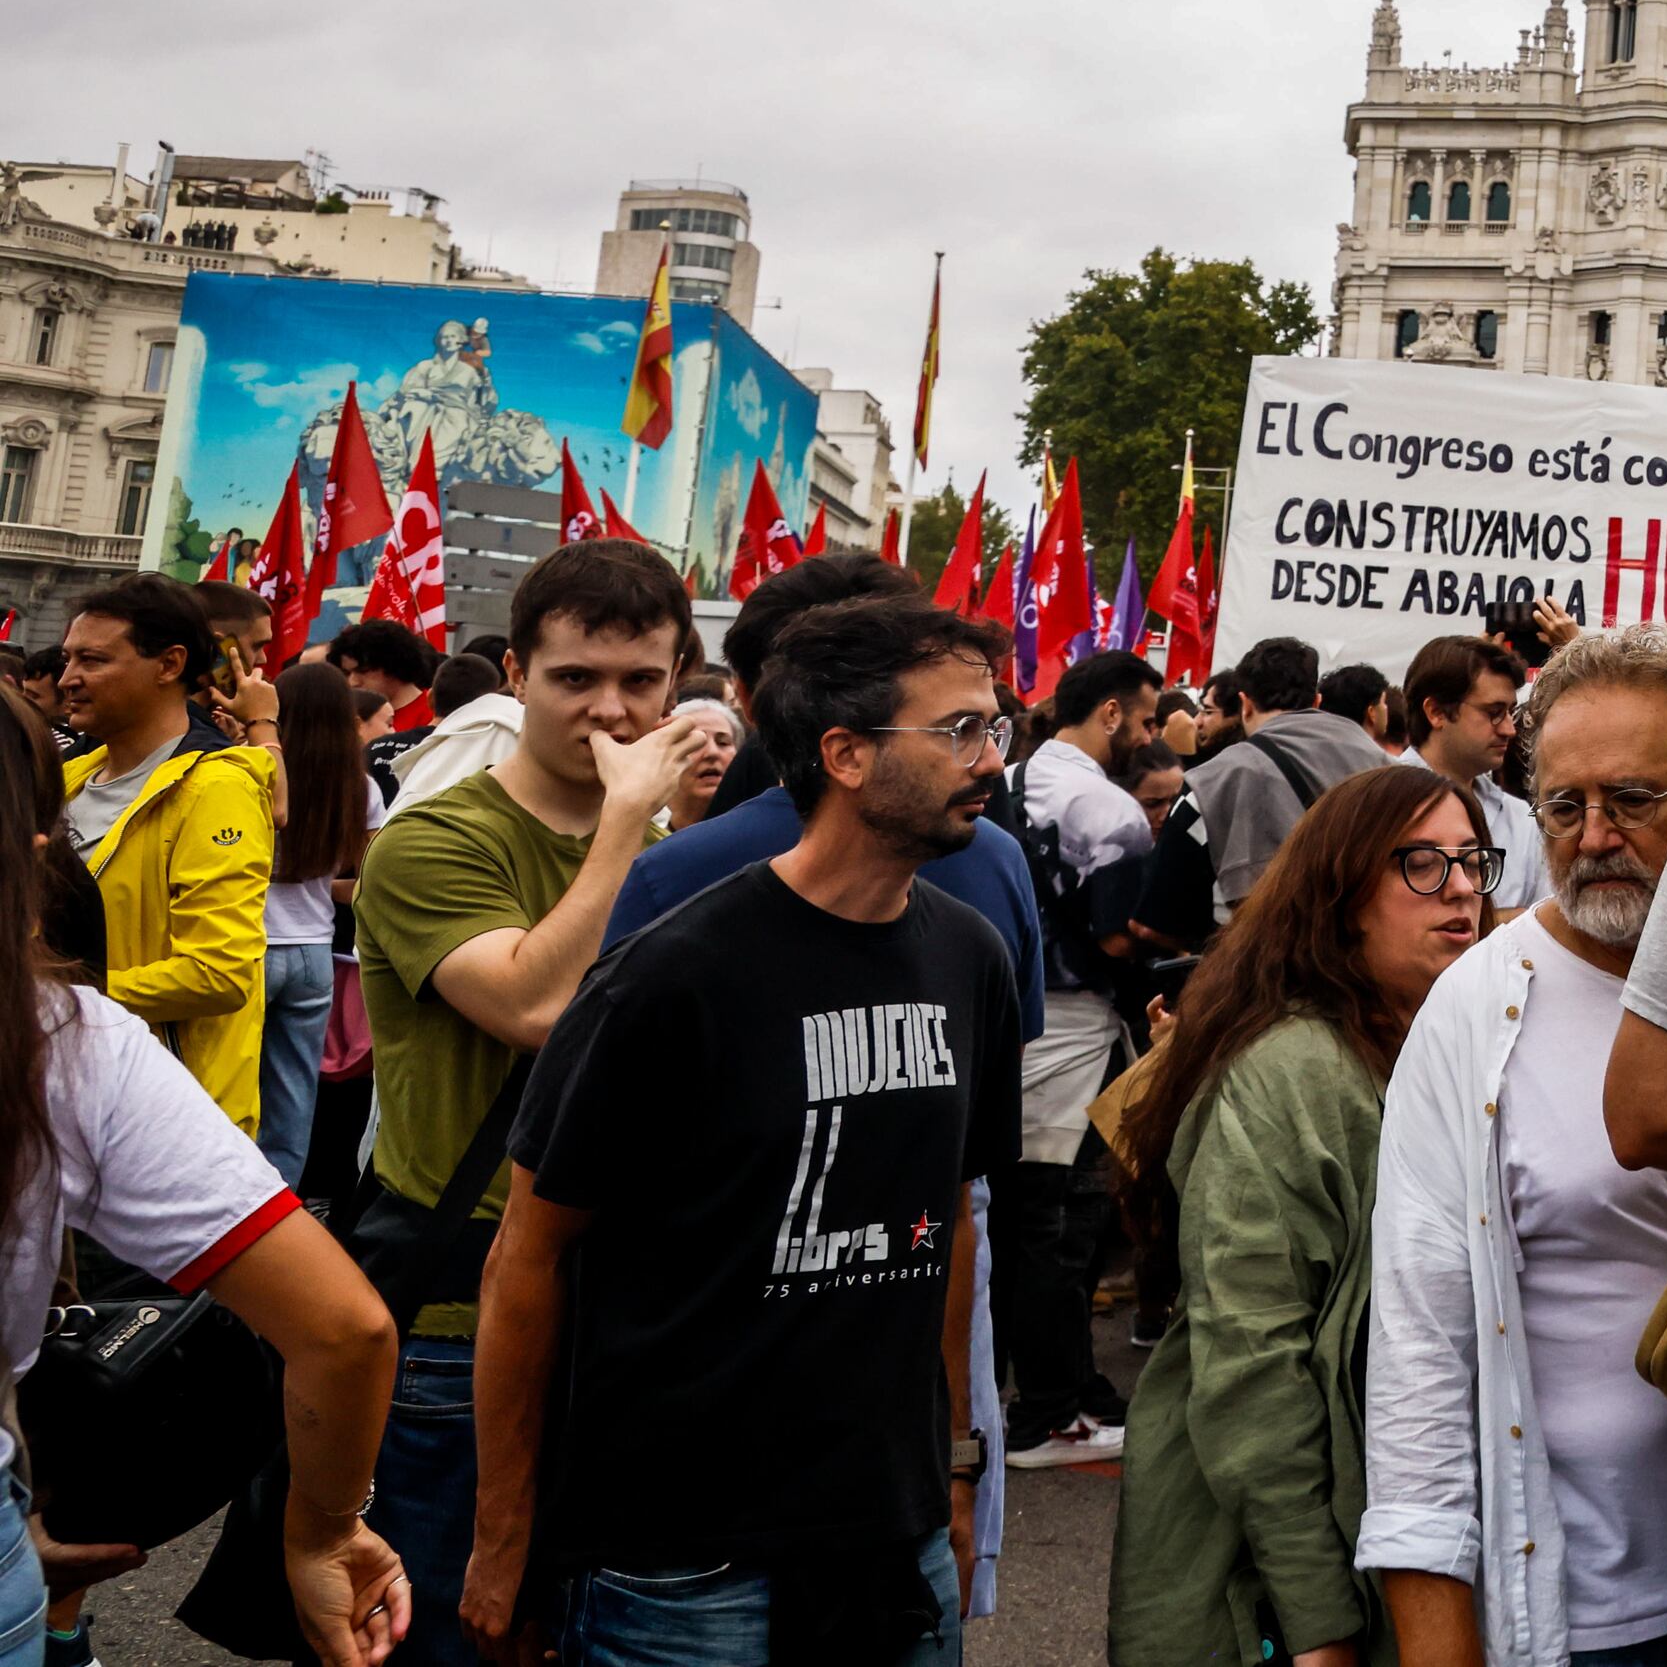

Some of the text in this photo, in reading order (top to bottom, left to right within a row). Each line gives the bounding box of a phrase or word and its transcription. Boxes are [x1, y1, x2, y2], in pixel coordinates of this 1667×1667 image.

[1256, 401, 1303, 457] El
[1312, 402, 1514, 480] Congreso
[1528, 435, 1611, 485] está
[1275, 497, 1592, 565] CONSTRUYAMOS
[1271, 559, 1387, 610] DESDE
[802, 1003, 957, 1102] MUJERES
[763, 1284, 790, 1298] 75
